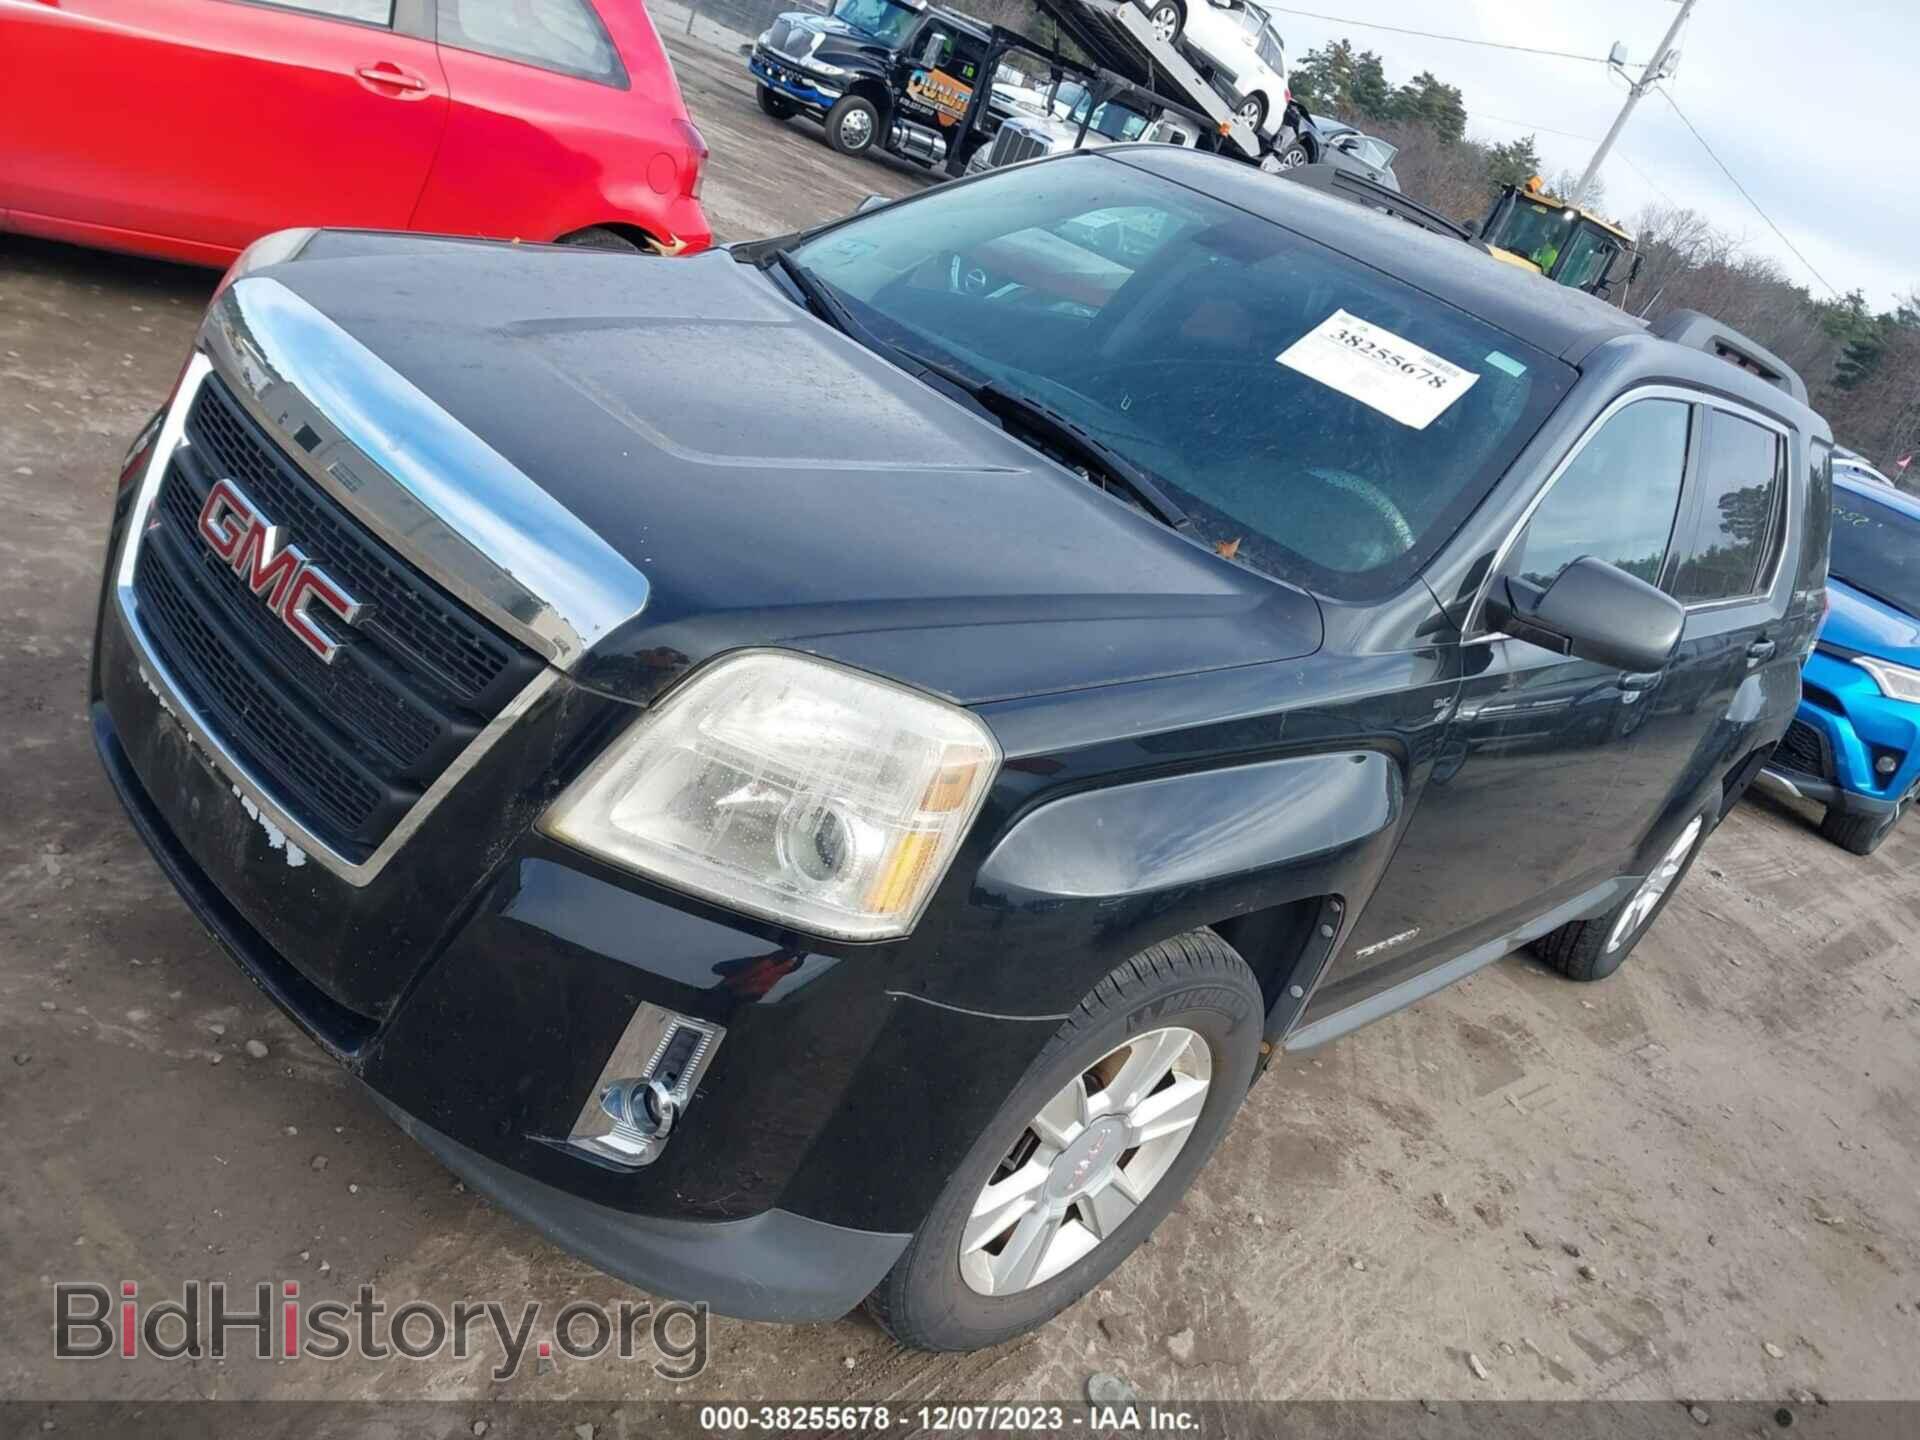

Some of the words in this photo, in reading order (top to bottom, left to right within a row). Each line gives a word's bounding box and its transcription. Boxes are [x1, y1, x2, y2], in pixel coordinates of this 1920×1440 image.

[906, 68, 971, 112] QUALIT
[1330, 328, 1447, 389] 38255678
[198, 478, 362, 665] GMC
